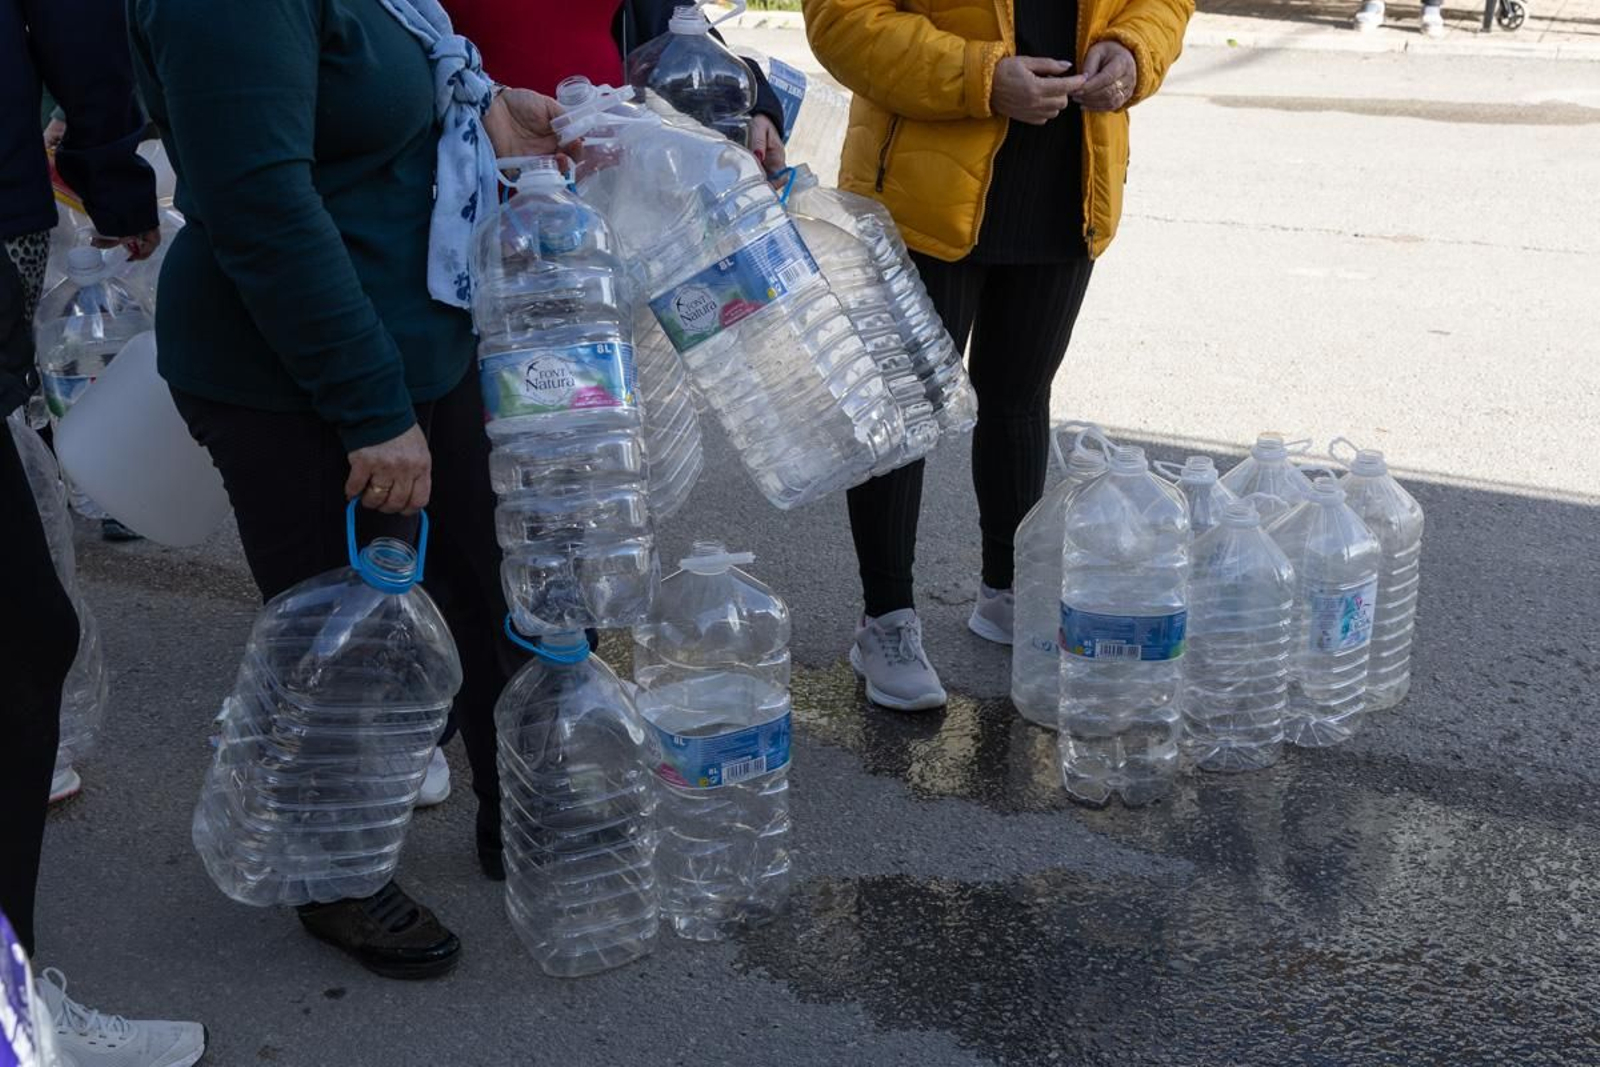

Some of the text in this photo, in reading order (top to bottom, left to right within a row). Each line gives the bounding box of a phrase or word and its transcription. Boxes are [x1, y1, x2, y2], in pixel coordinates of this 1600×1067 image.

[719, 258, 734, 270] 8L
[686, 297, 706, 311] FONT
[681, 301, 718, 327] Natura
[596, 344, 612, 354] 8L
[539, 369, 566, 379] FONT
[525, 377, 575, 392] Natura
